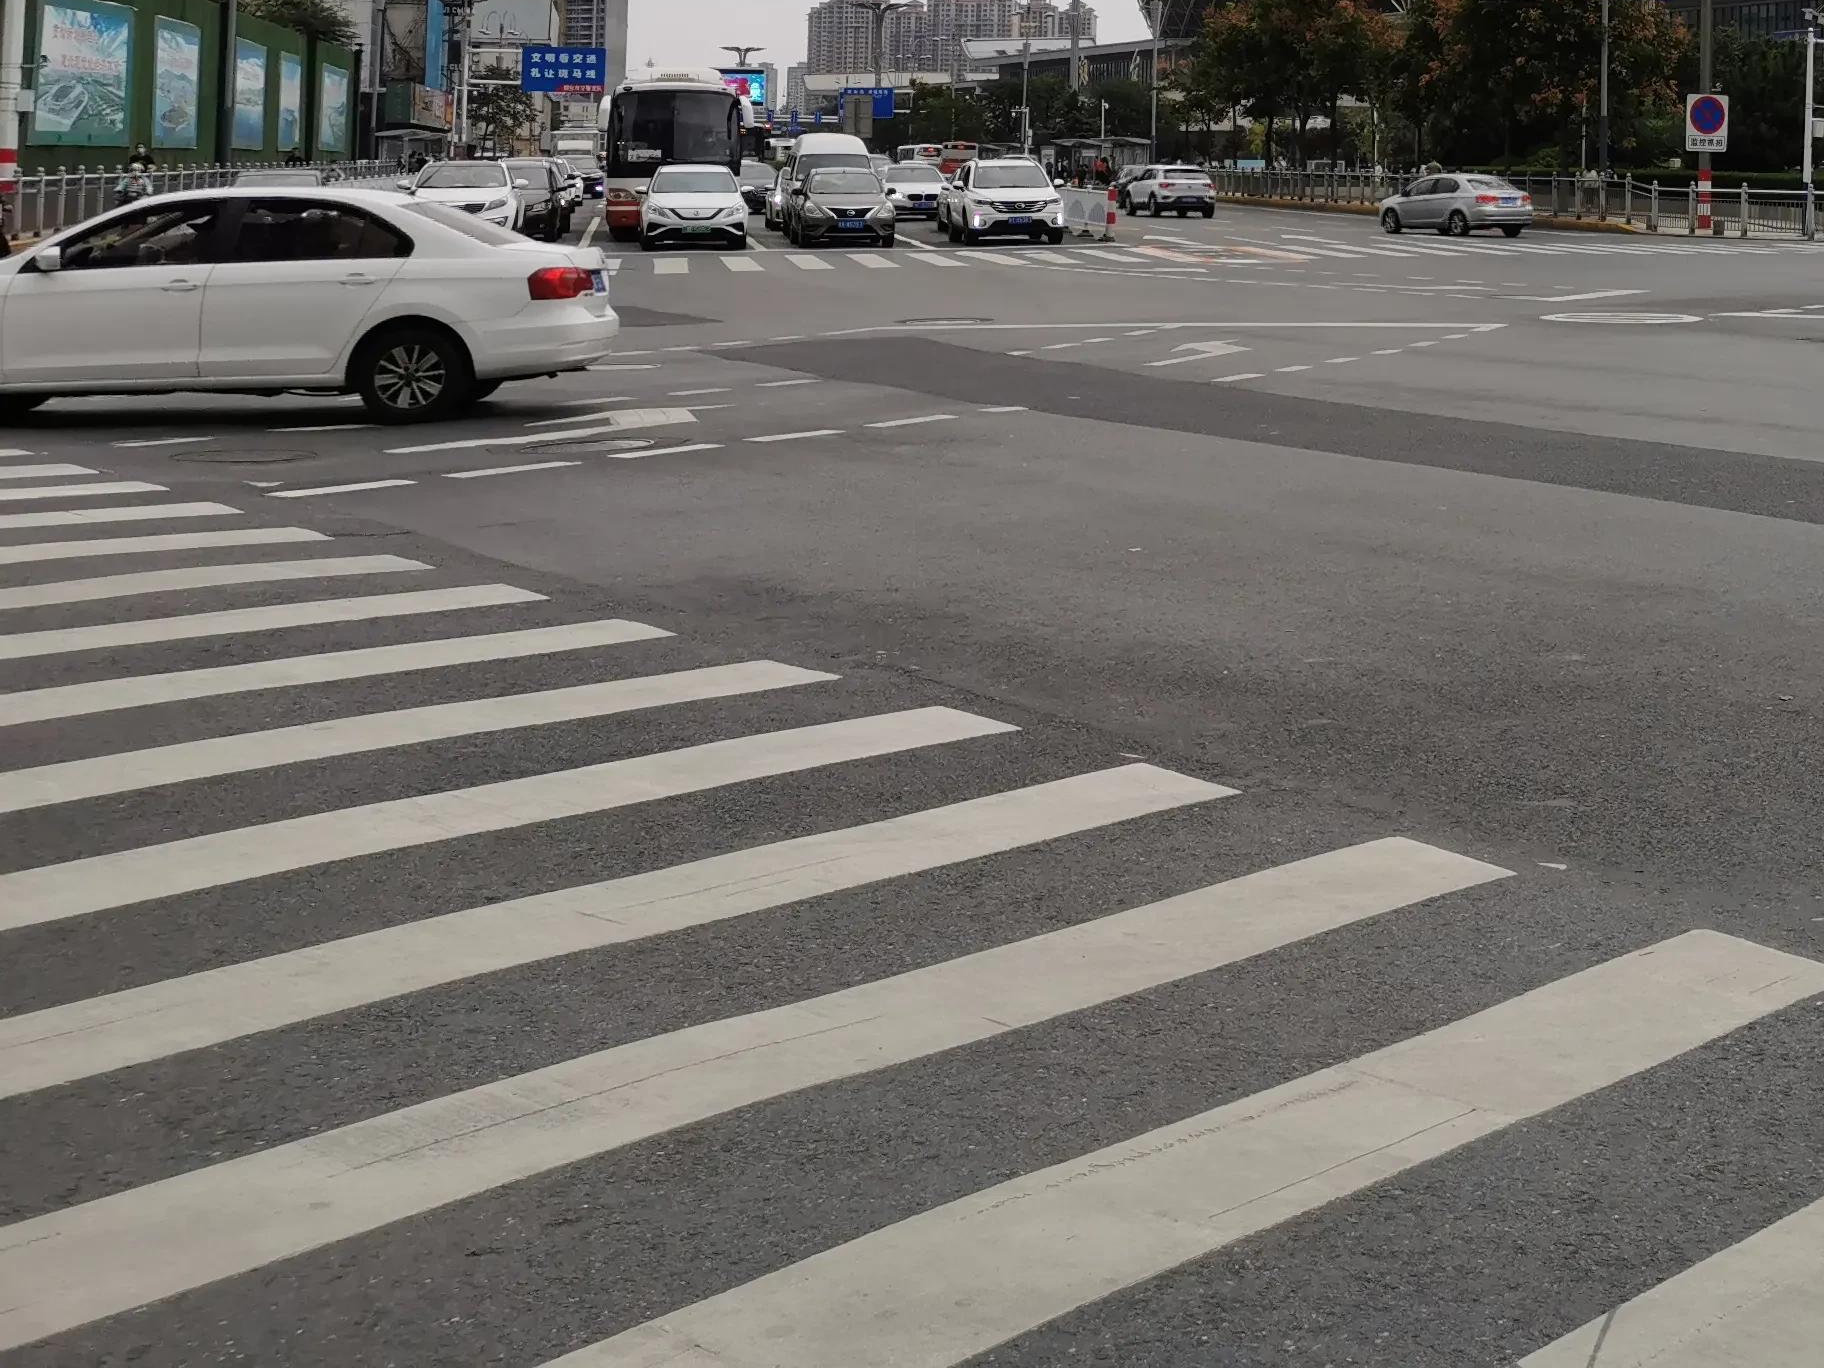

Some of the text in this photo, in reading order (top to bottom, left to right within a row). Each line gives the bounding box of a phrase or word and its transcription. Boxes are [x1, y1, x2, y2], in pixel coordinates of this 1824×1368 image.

[530, 67, 597, 79] 礼让斑马线
